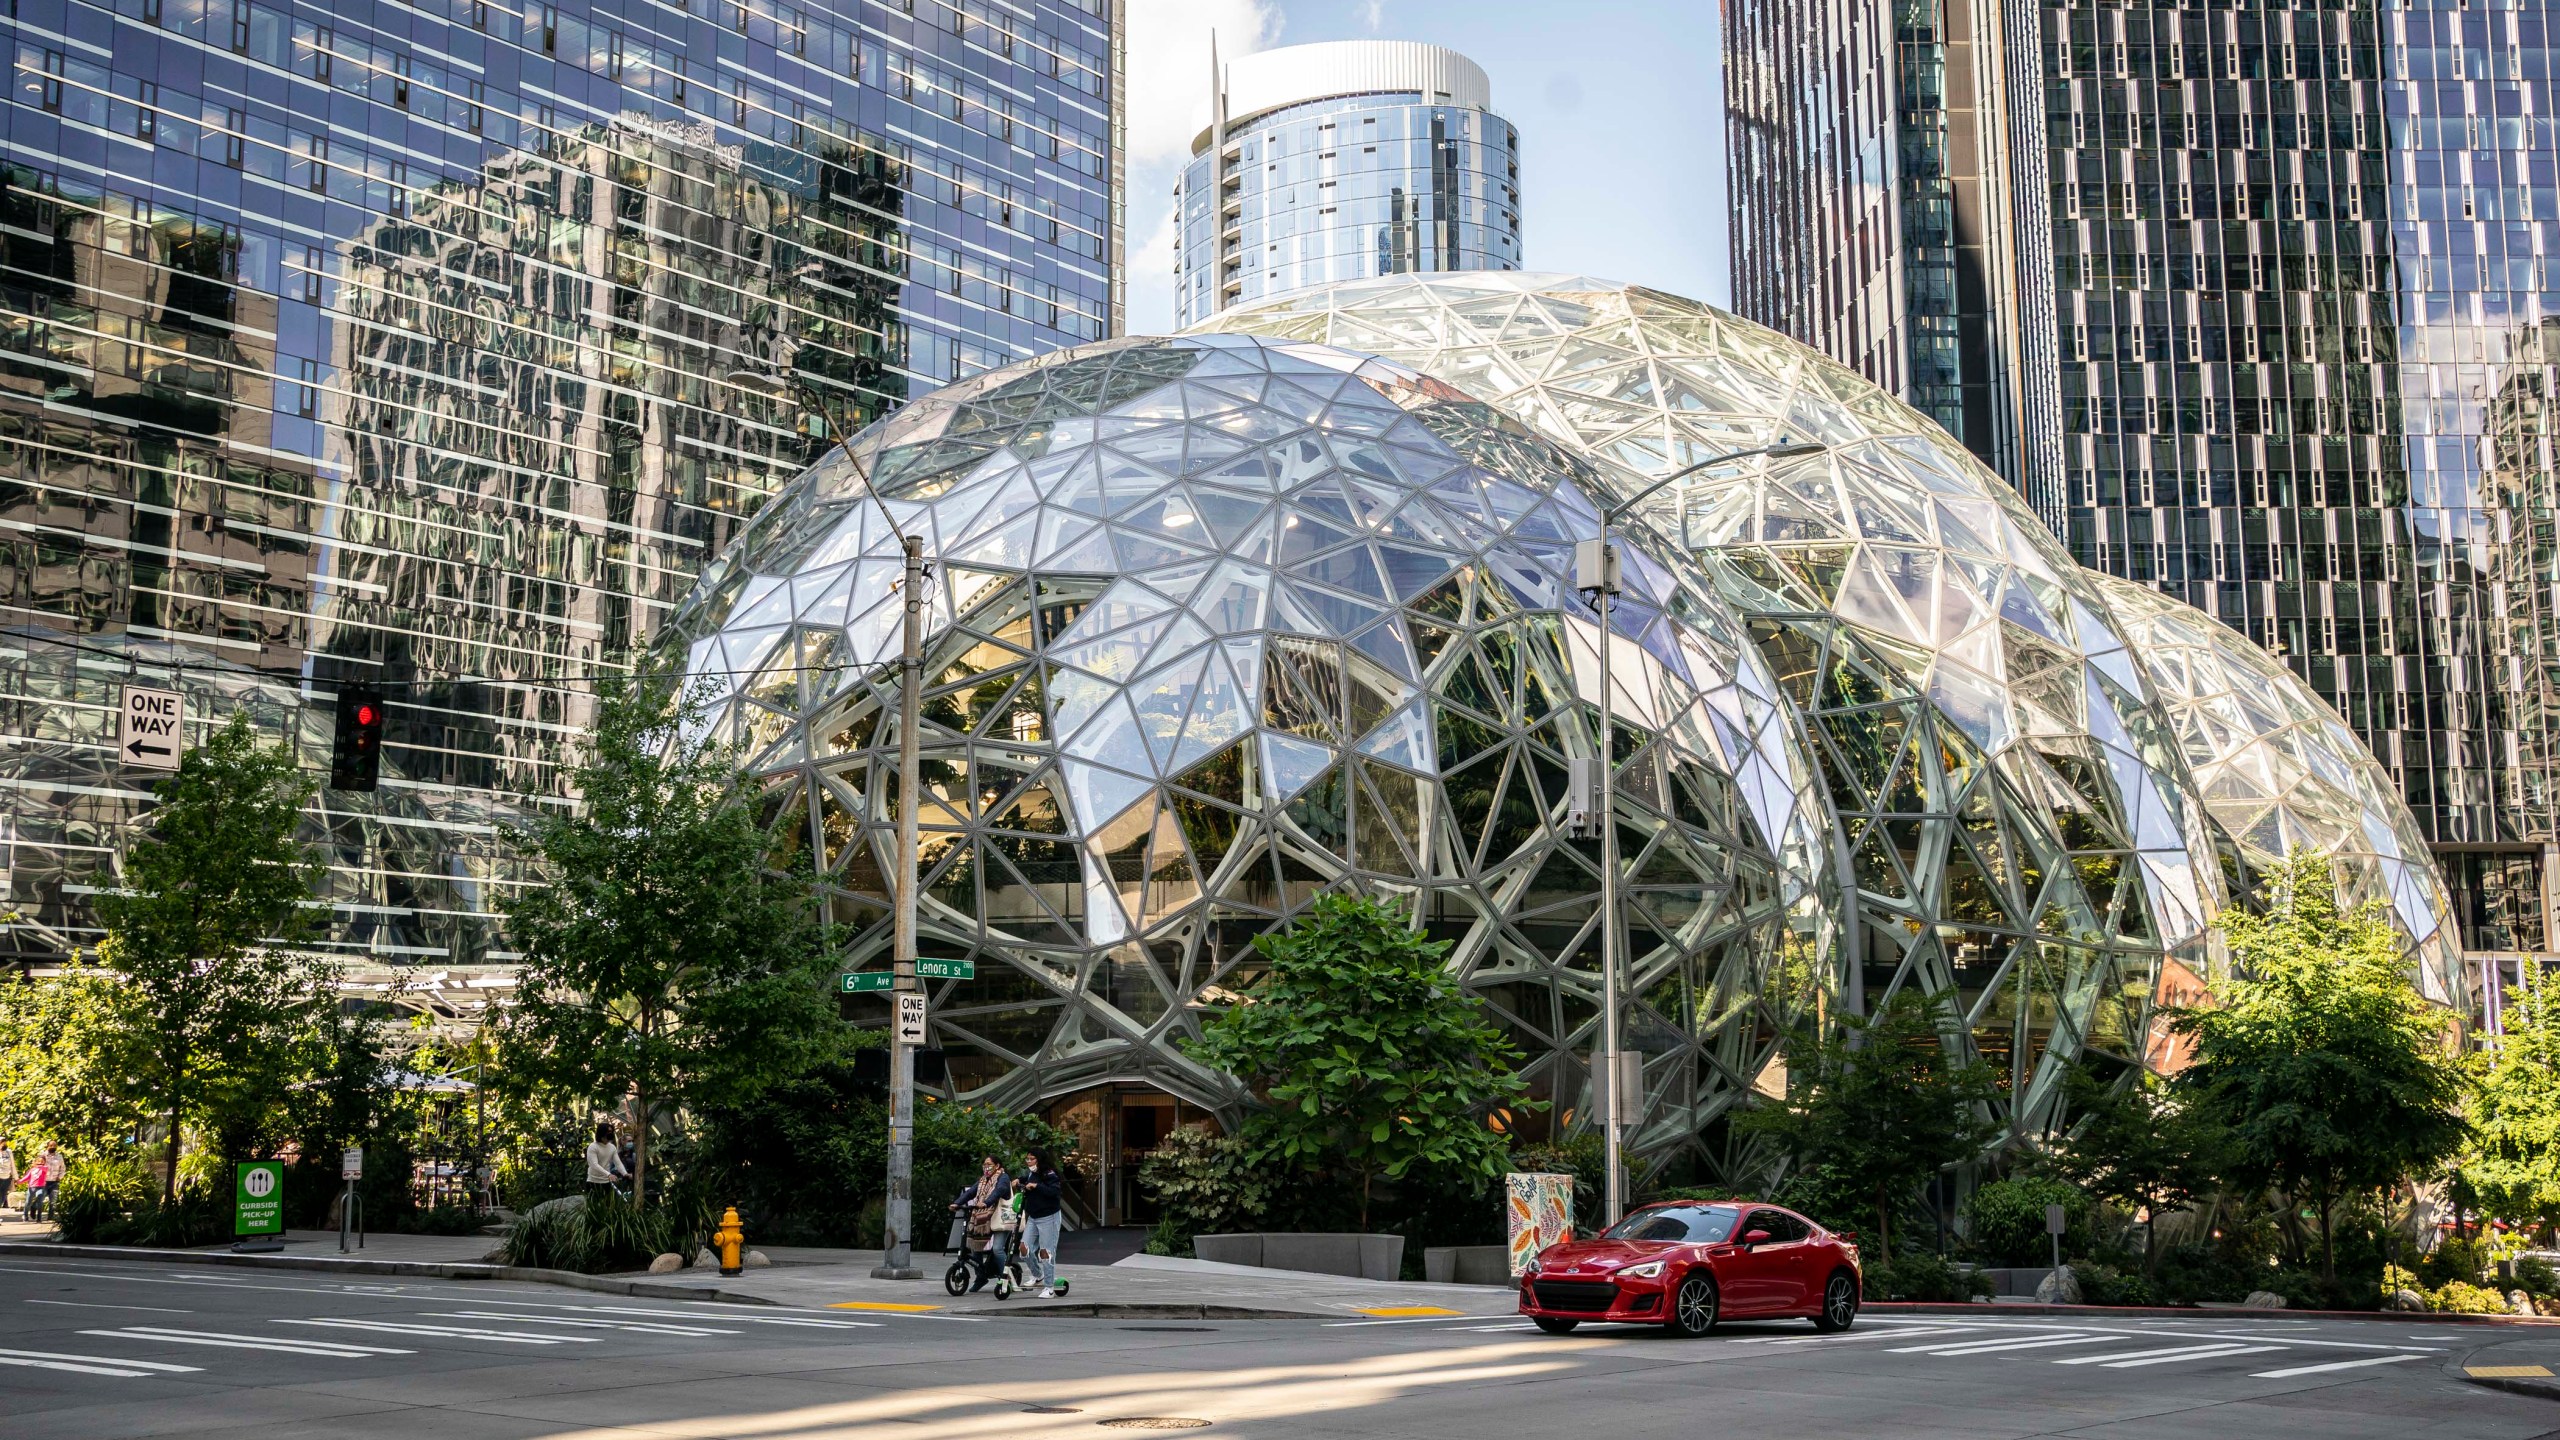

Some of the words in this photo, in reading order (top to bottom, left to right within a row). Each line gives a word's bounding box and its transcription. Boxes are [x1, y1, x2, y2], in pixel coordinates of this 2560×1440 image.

[131, 694, 176, 716] ONE
[131, 715, 176, 736] WAY
[917, 959, 948, 975] Lenora
[953, 966, 961, 976] St
[846, 975, 859, 990] 6th
[876, 976, 890, 986] Ave
[902, 998, 923, 1010] ONE
[902, 1012, 923, 1024] WAY
[240, 1201, 279, 1210] CURBSIDE
[242, 1210, 276, 1218] PICK-UP
[248, 1219, 269, 1227] HERE
